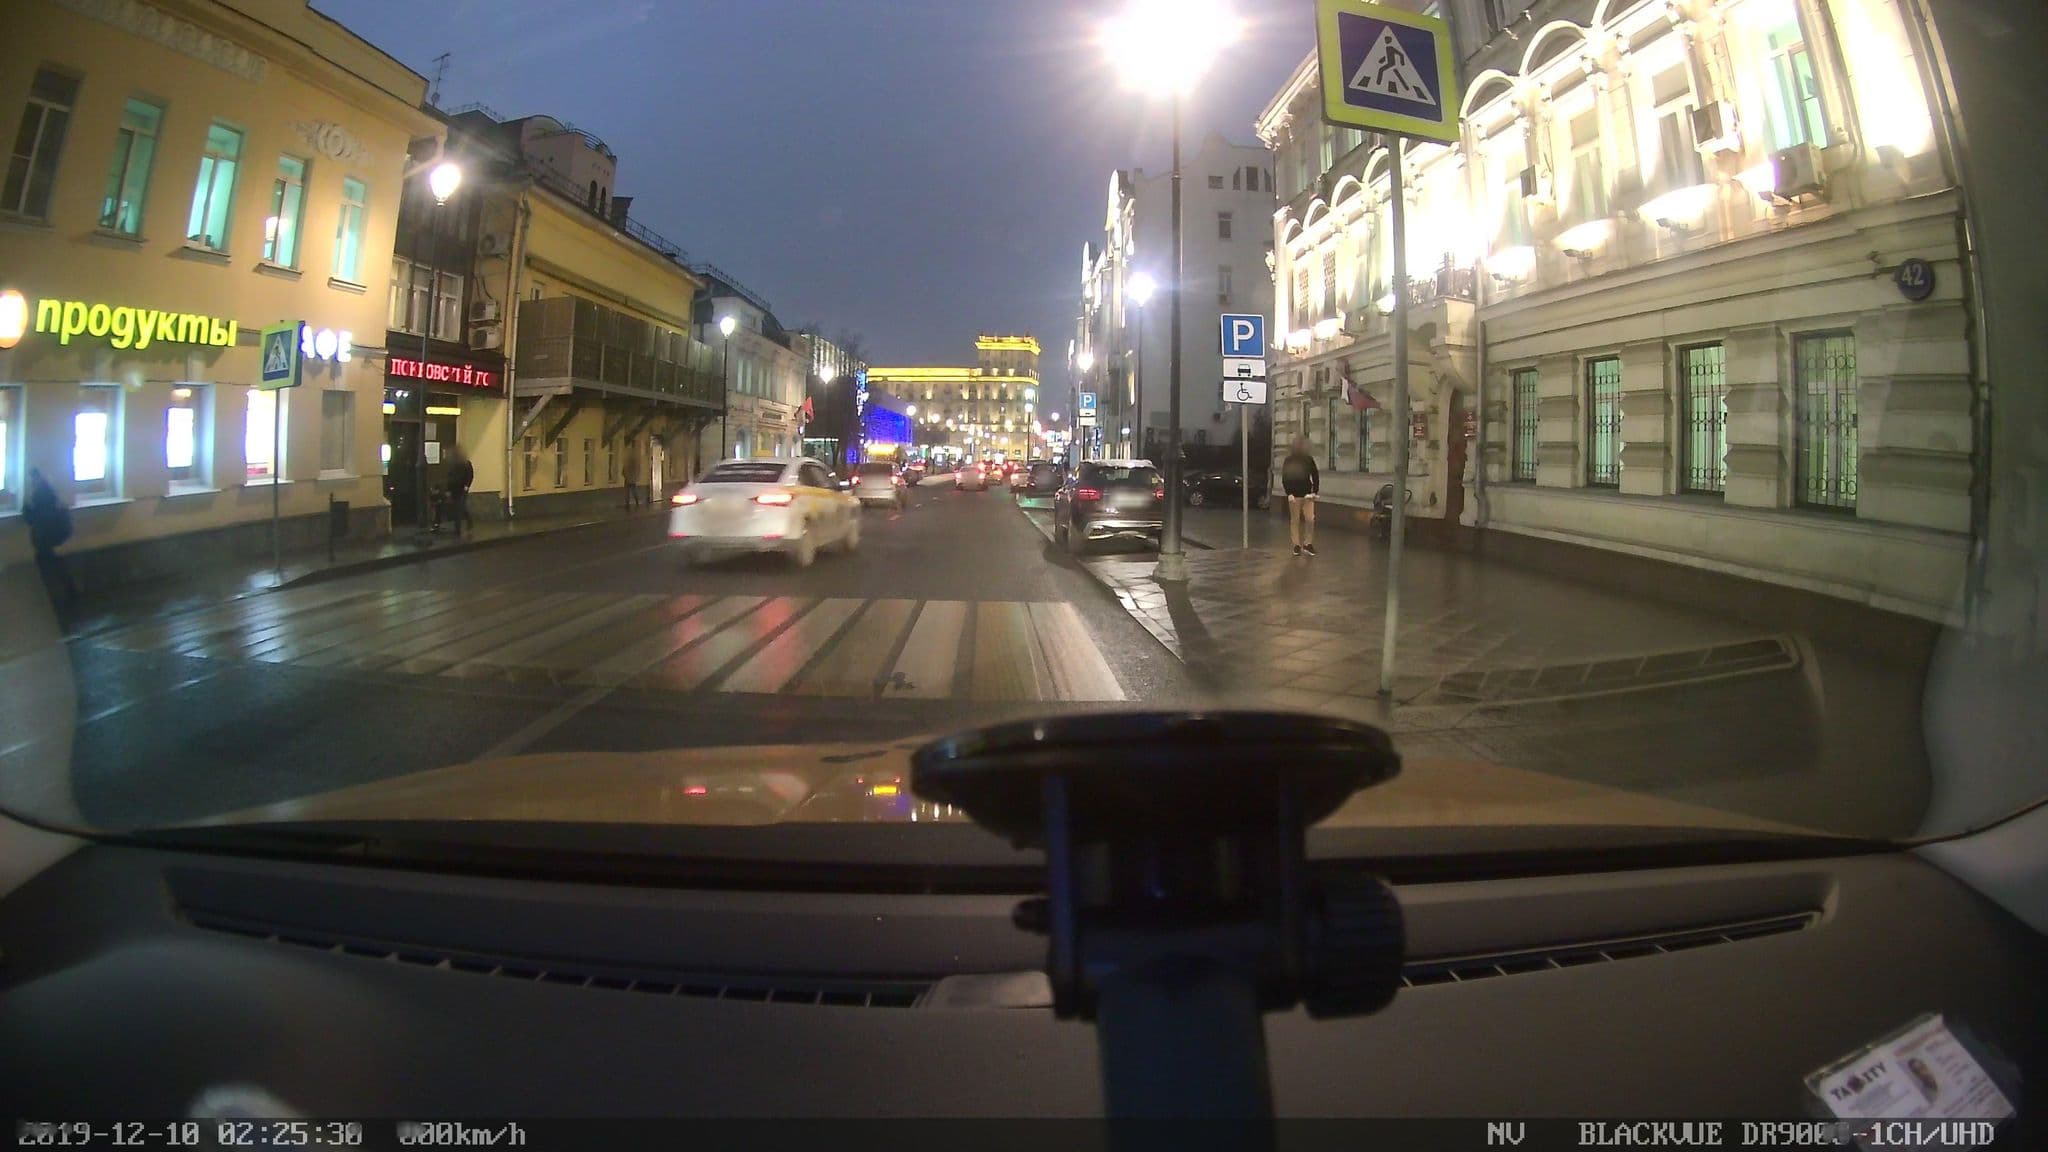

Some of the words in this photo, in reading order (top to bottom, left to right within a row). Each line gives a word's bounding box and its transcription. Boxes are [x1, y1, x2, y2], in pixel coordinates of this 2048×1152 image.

[1902, 263, 1925, 287] 42
[35, 298, 239, 350] продукты
[1232, 319, 1255, 352] P
[301, 325, 353, 363] АФЕ
